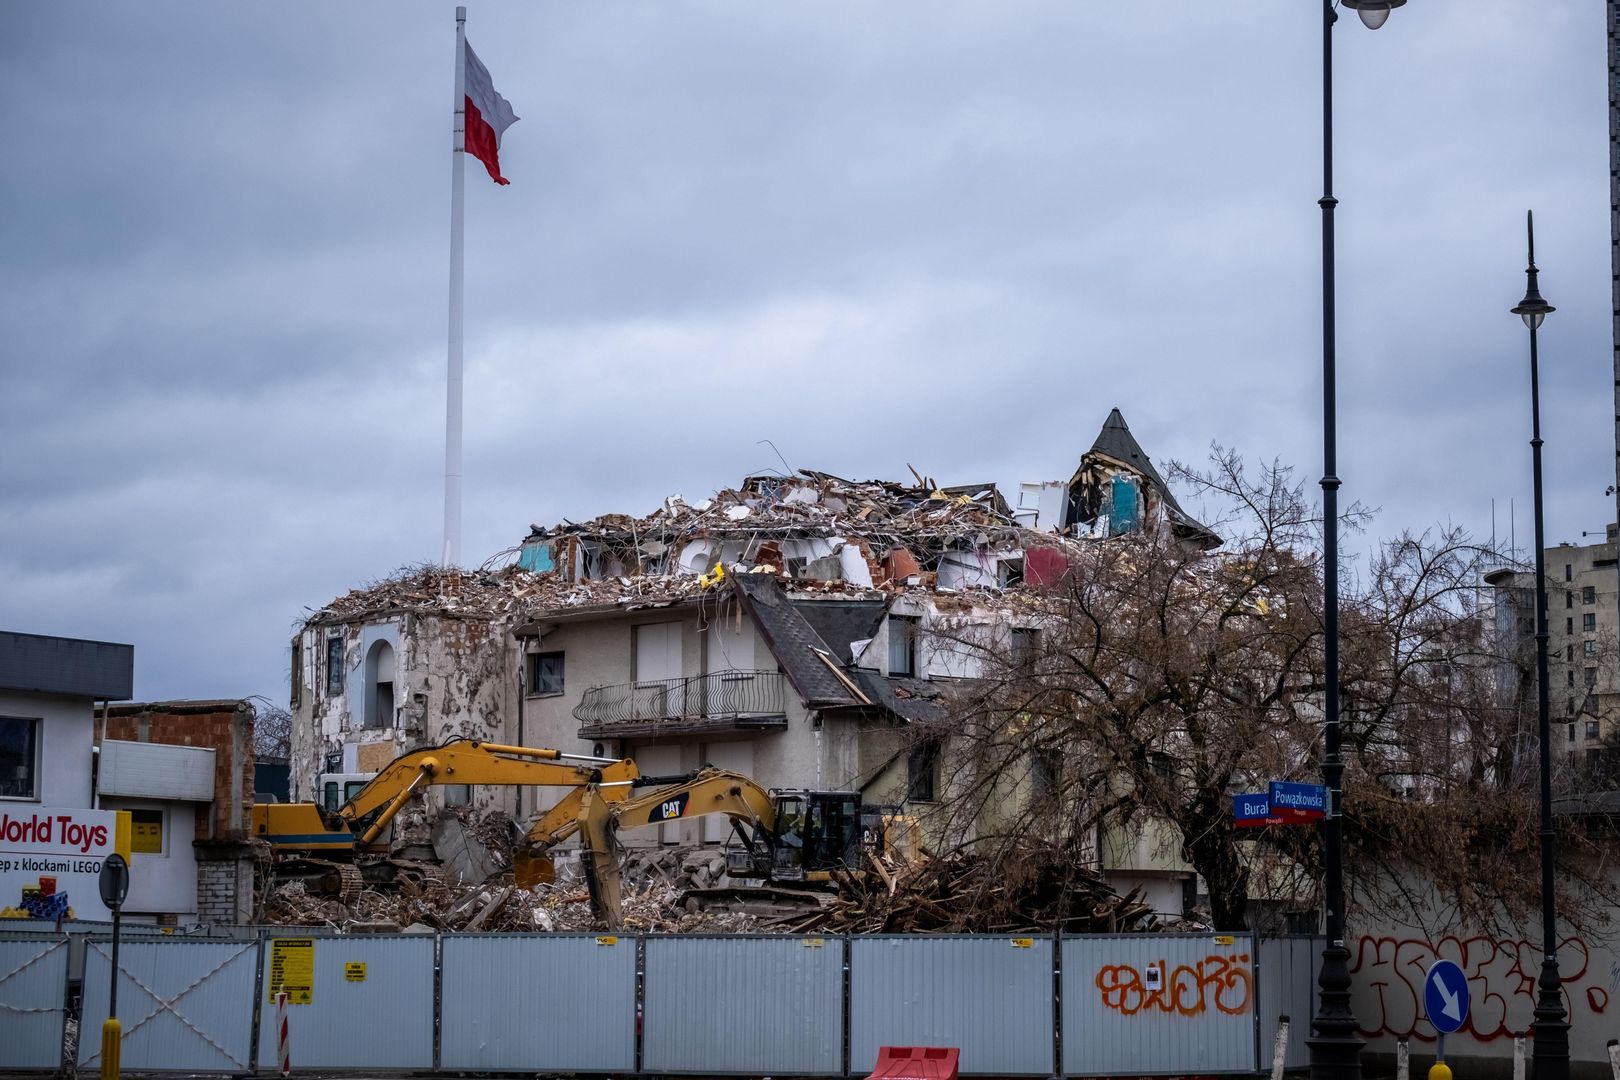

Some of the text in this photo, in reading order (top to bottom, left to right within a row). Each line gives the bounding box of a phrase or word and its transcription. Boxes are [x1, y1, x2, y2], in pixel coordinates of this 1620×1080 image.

[1275, 790, 1323, 808] Powązkowska
[662, 801, 680, 819] CAT
[57, 816, 108, 853] Toys
[14, 861, 19, 871] z
[22, 858, 70, 872] klockami
[73, 861, 100, 873] LEGO
